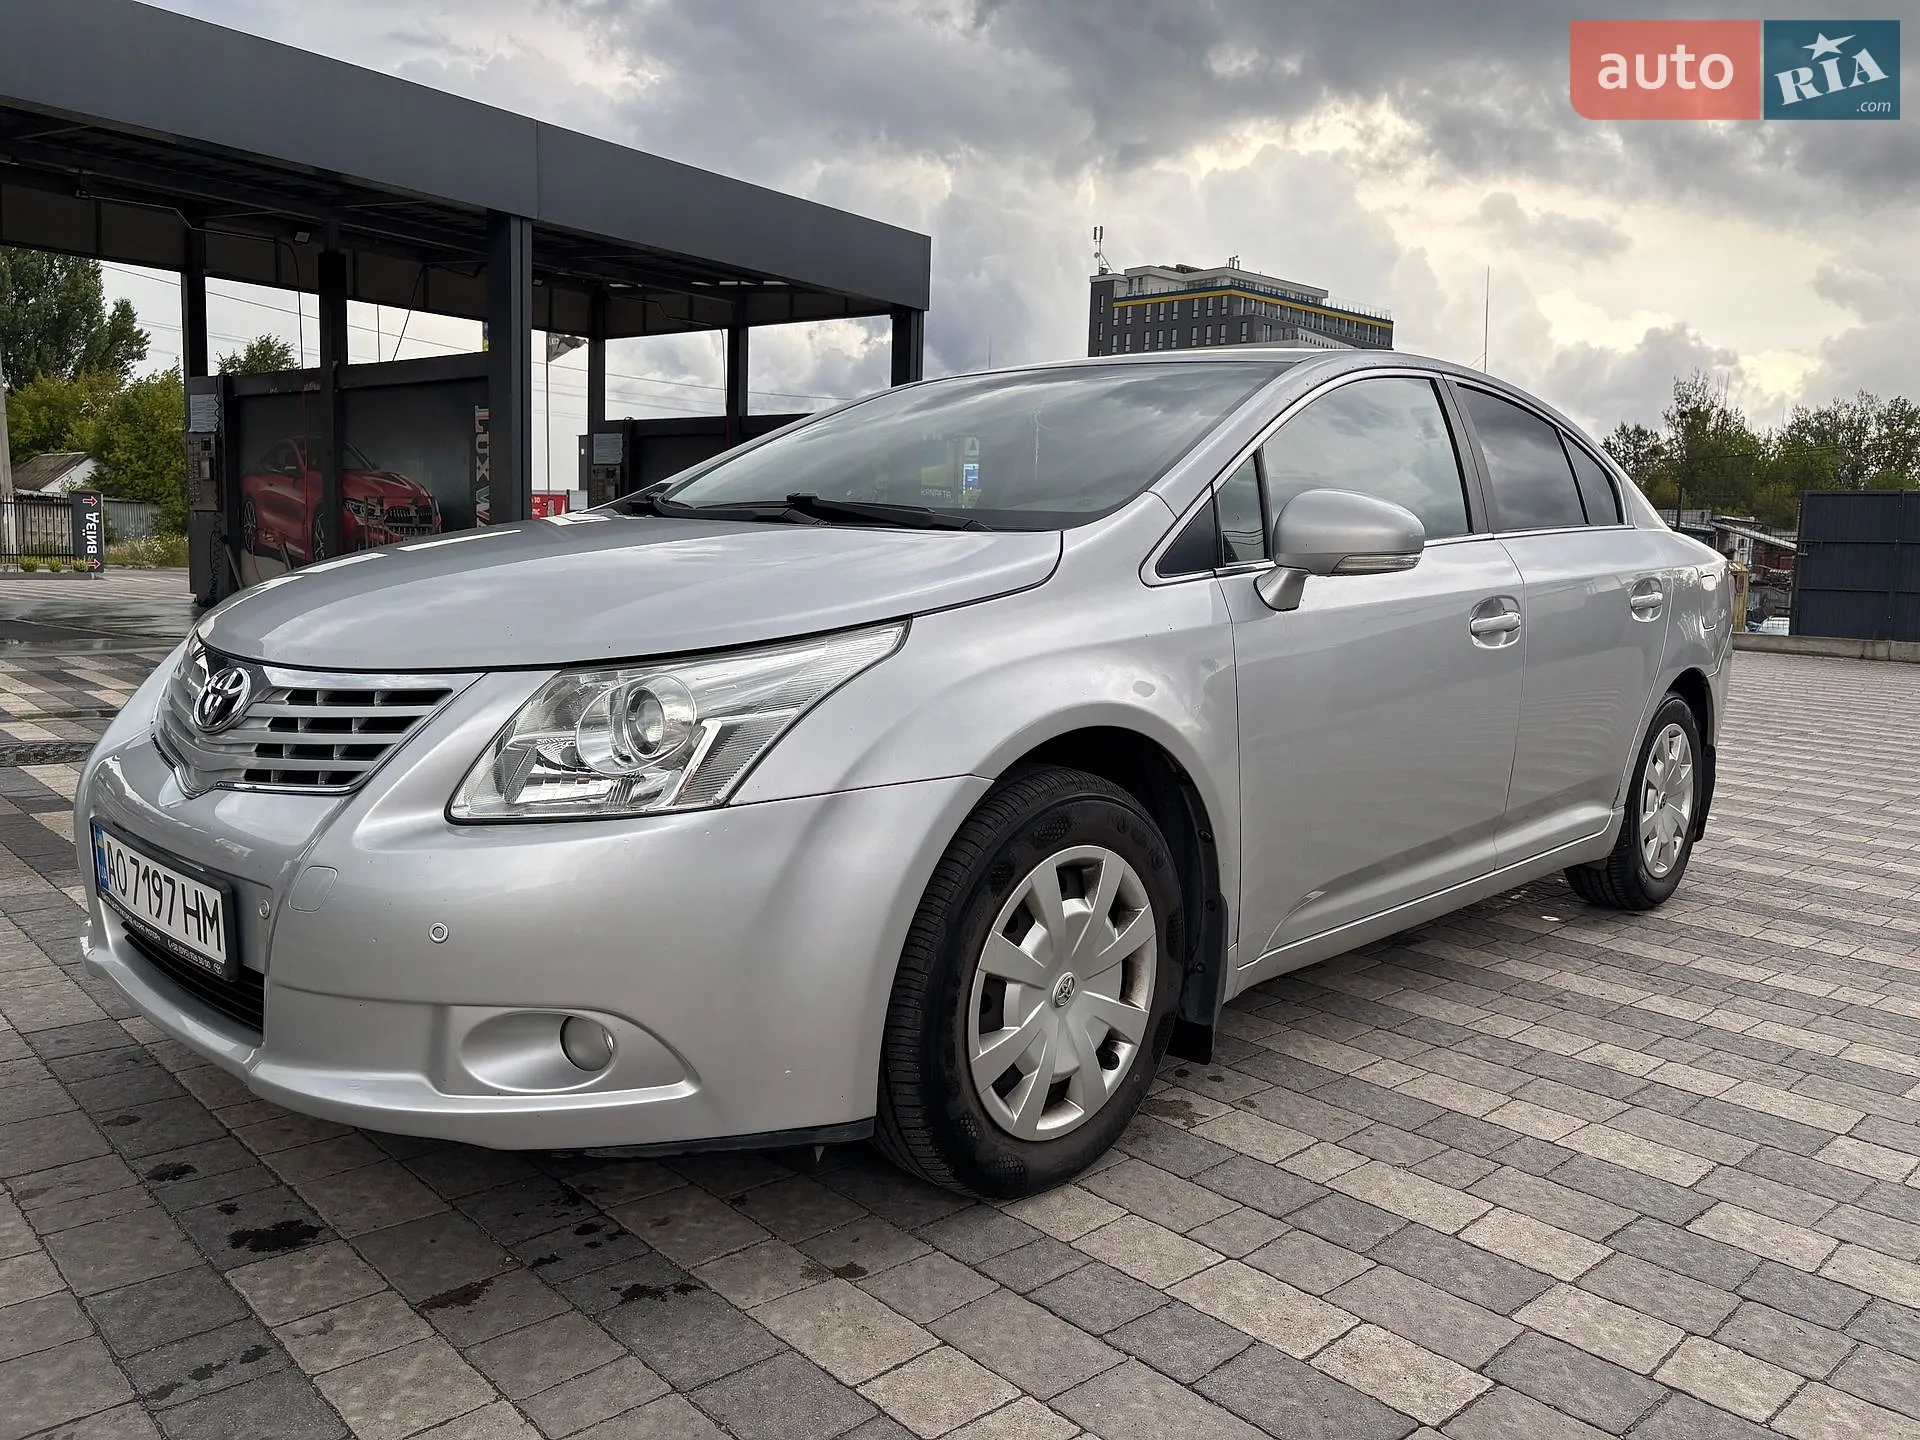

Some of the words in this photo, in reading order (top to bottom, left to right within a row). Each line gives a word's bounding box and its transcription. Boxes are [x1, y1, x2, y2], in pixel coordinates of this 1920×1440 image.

[475, 405, 490, 481] LUX
[82, 512, 100, 554] ВИЇЗД
[107, 840, 127, 897] AO
[129, 855, 176, 926] 7197
[181, 882, 222, 952] HM
